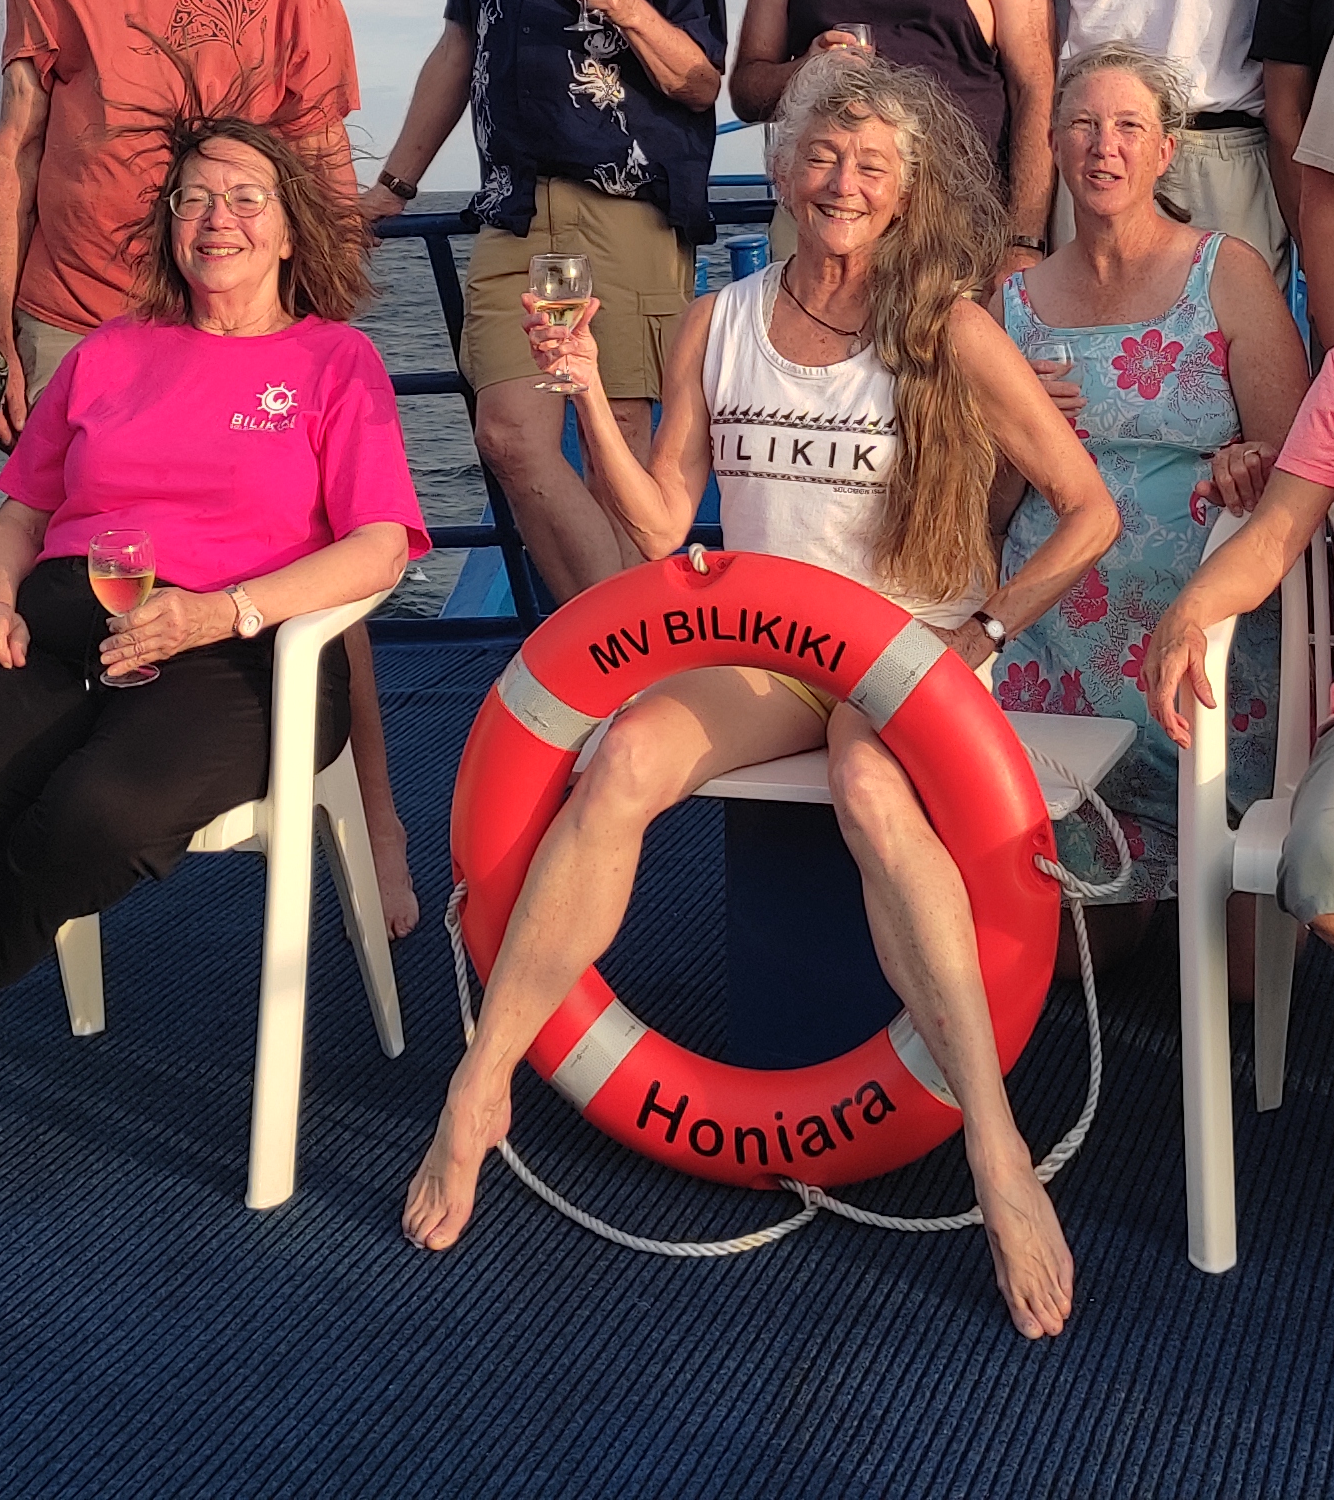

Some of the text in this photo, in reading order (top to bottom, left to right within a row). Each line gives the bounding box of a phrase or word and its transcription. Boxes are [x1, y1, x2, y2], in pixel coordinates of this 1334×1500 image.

[710, 434, 878, 472] ILIKIK
[588, 605, 847, 675] MV BILIKIKI
[636, 1079, 897, 1166] Honiara
